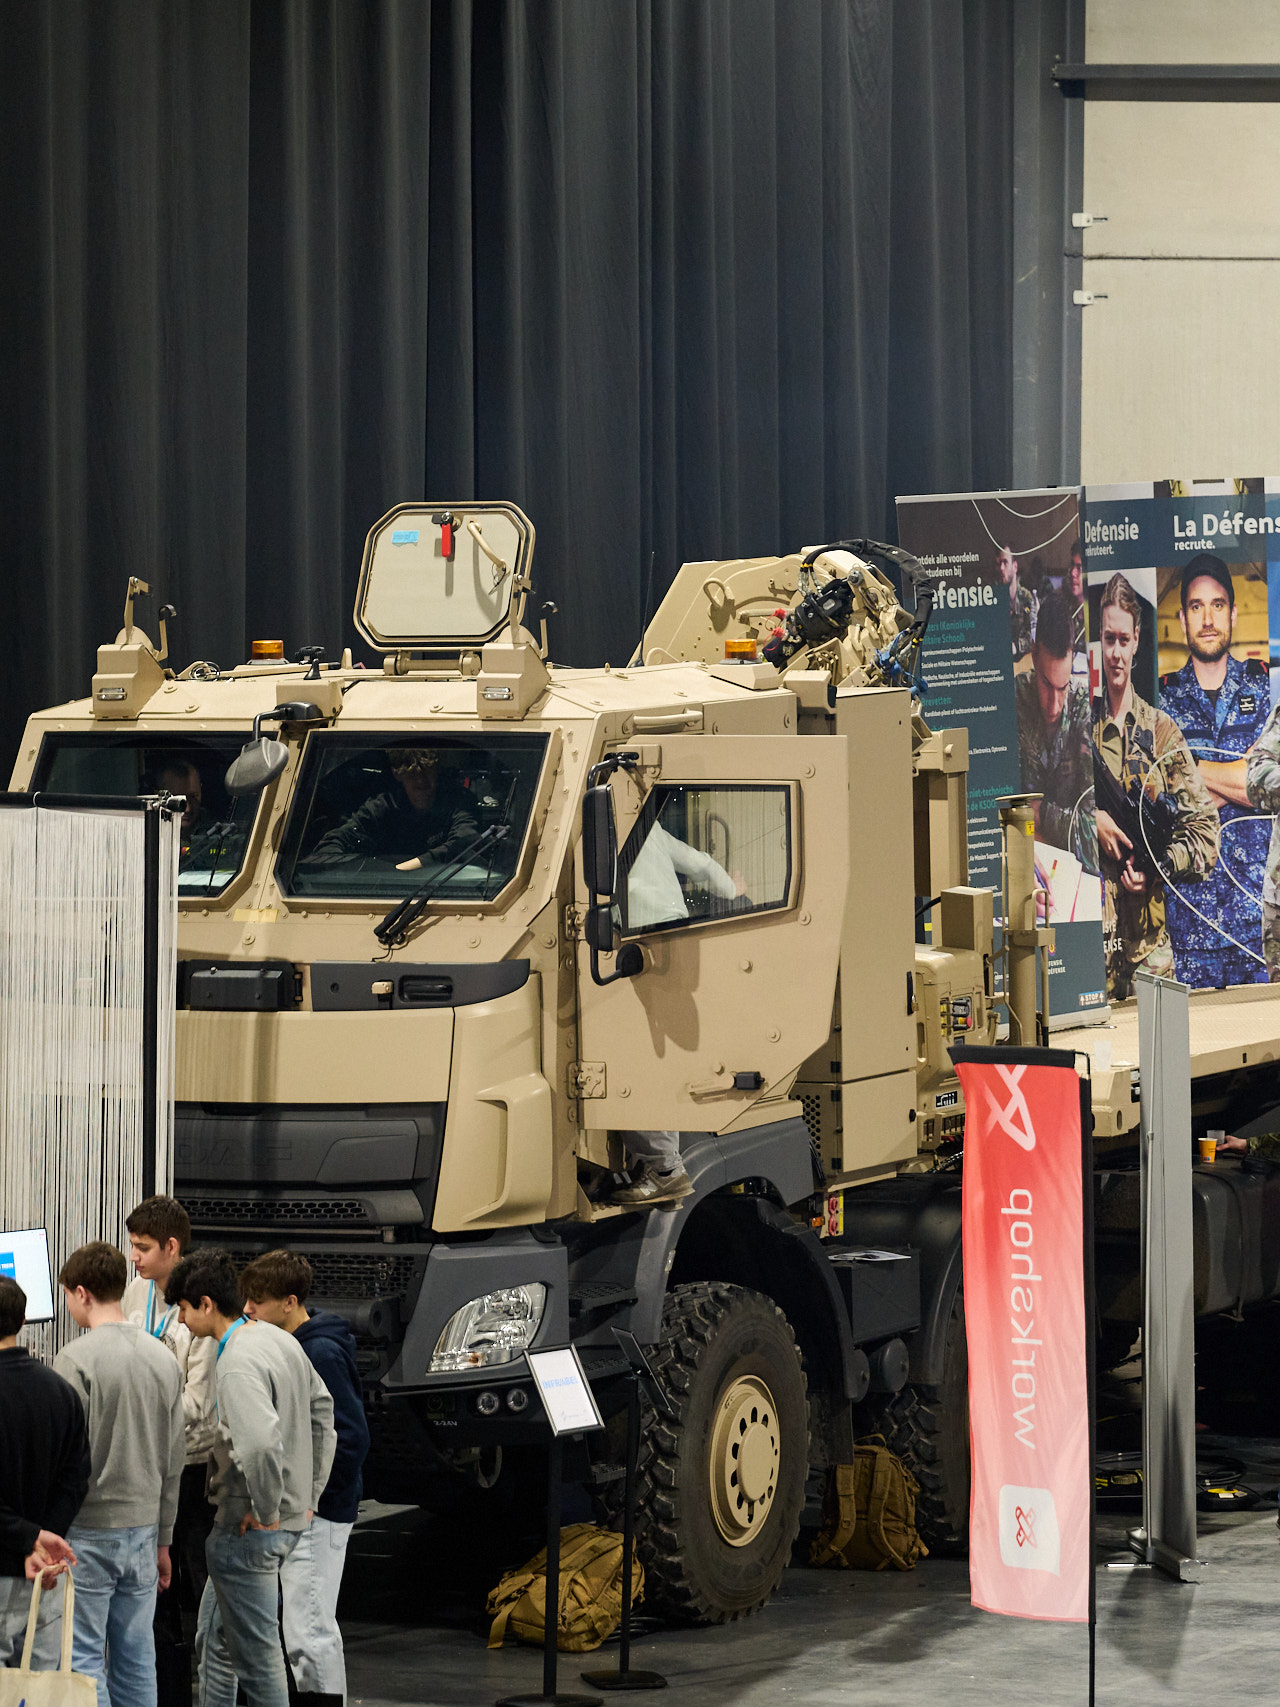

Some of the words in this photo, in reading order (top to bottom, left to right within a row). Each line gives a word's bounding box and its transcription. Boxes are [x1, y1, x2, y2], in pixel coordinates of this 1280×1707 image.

[1084, 517, 1140, 544] Defensie
[1173, 515, 1197, 538] La
[1174, 538, 1216, 551] recrute.
[936, 553, 949, 564] alle
[948, 552, 980, 563] voordelen
[953, 565, 963, 578] bij
[914, 577, 998, 611] efensie.
[1103, 938, 1123, 954] ENSE
